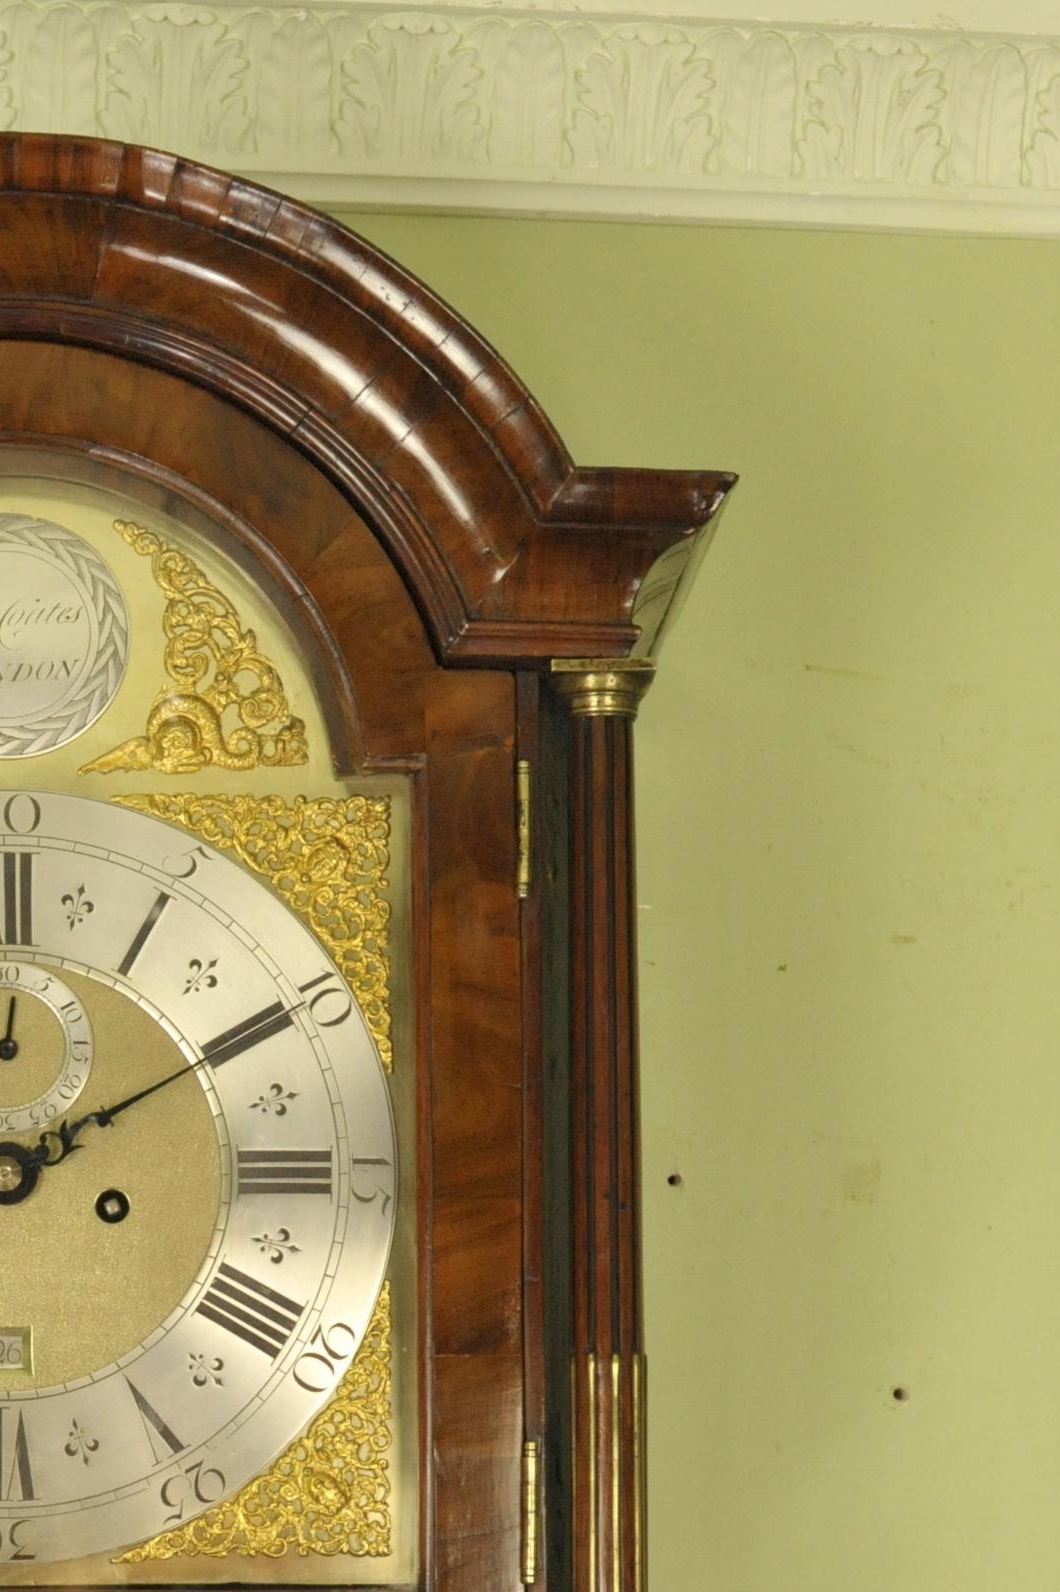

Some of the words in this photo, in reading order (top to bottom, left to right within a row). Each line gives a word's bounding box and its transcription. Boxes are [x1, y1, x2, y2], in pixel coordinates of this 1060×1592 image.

[162, 845, 216, 878] 5
[111, 886, 177, 980] I
[34, 976, 55, 992] 5
[60, 1001, 83, 1024] 10
[297, 969, 352, 1027] 10
[72, 1041, 89, 1065] 15
[195, 993, 299, 1075] II
[29, 1103, 58, 1125] 25
[59, 1073, 81, 1100] 20
[237, 1144, 333, 1203] III
[351, 1152, 391, 1217] 15
[190, 1254, 309, 1367] IIII
[292, 1322, 355, 1393] 20
[123, 1373, 191, 1467] V
[160, 1460, 226, 1525] 25
